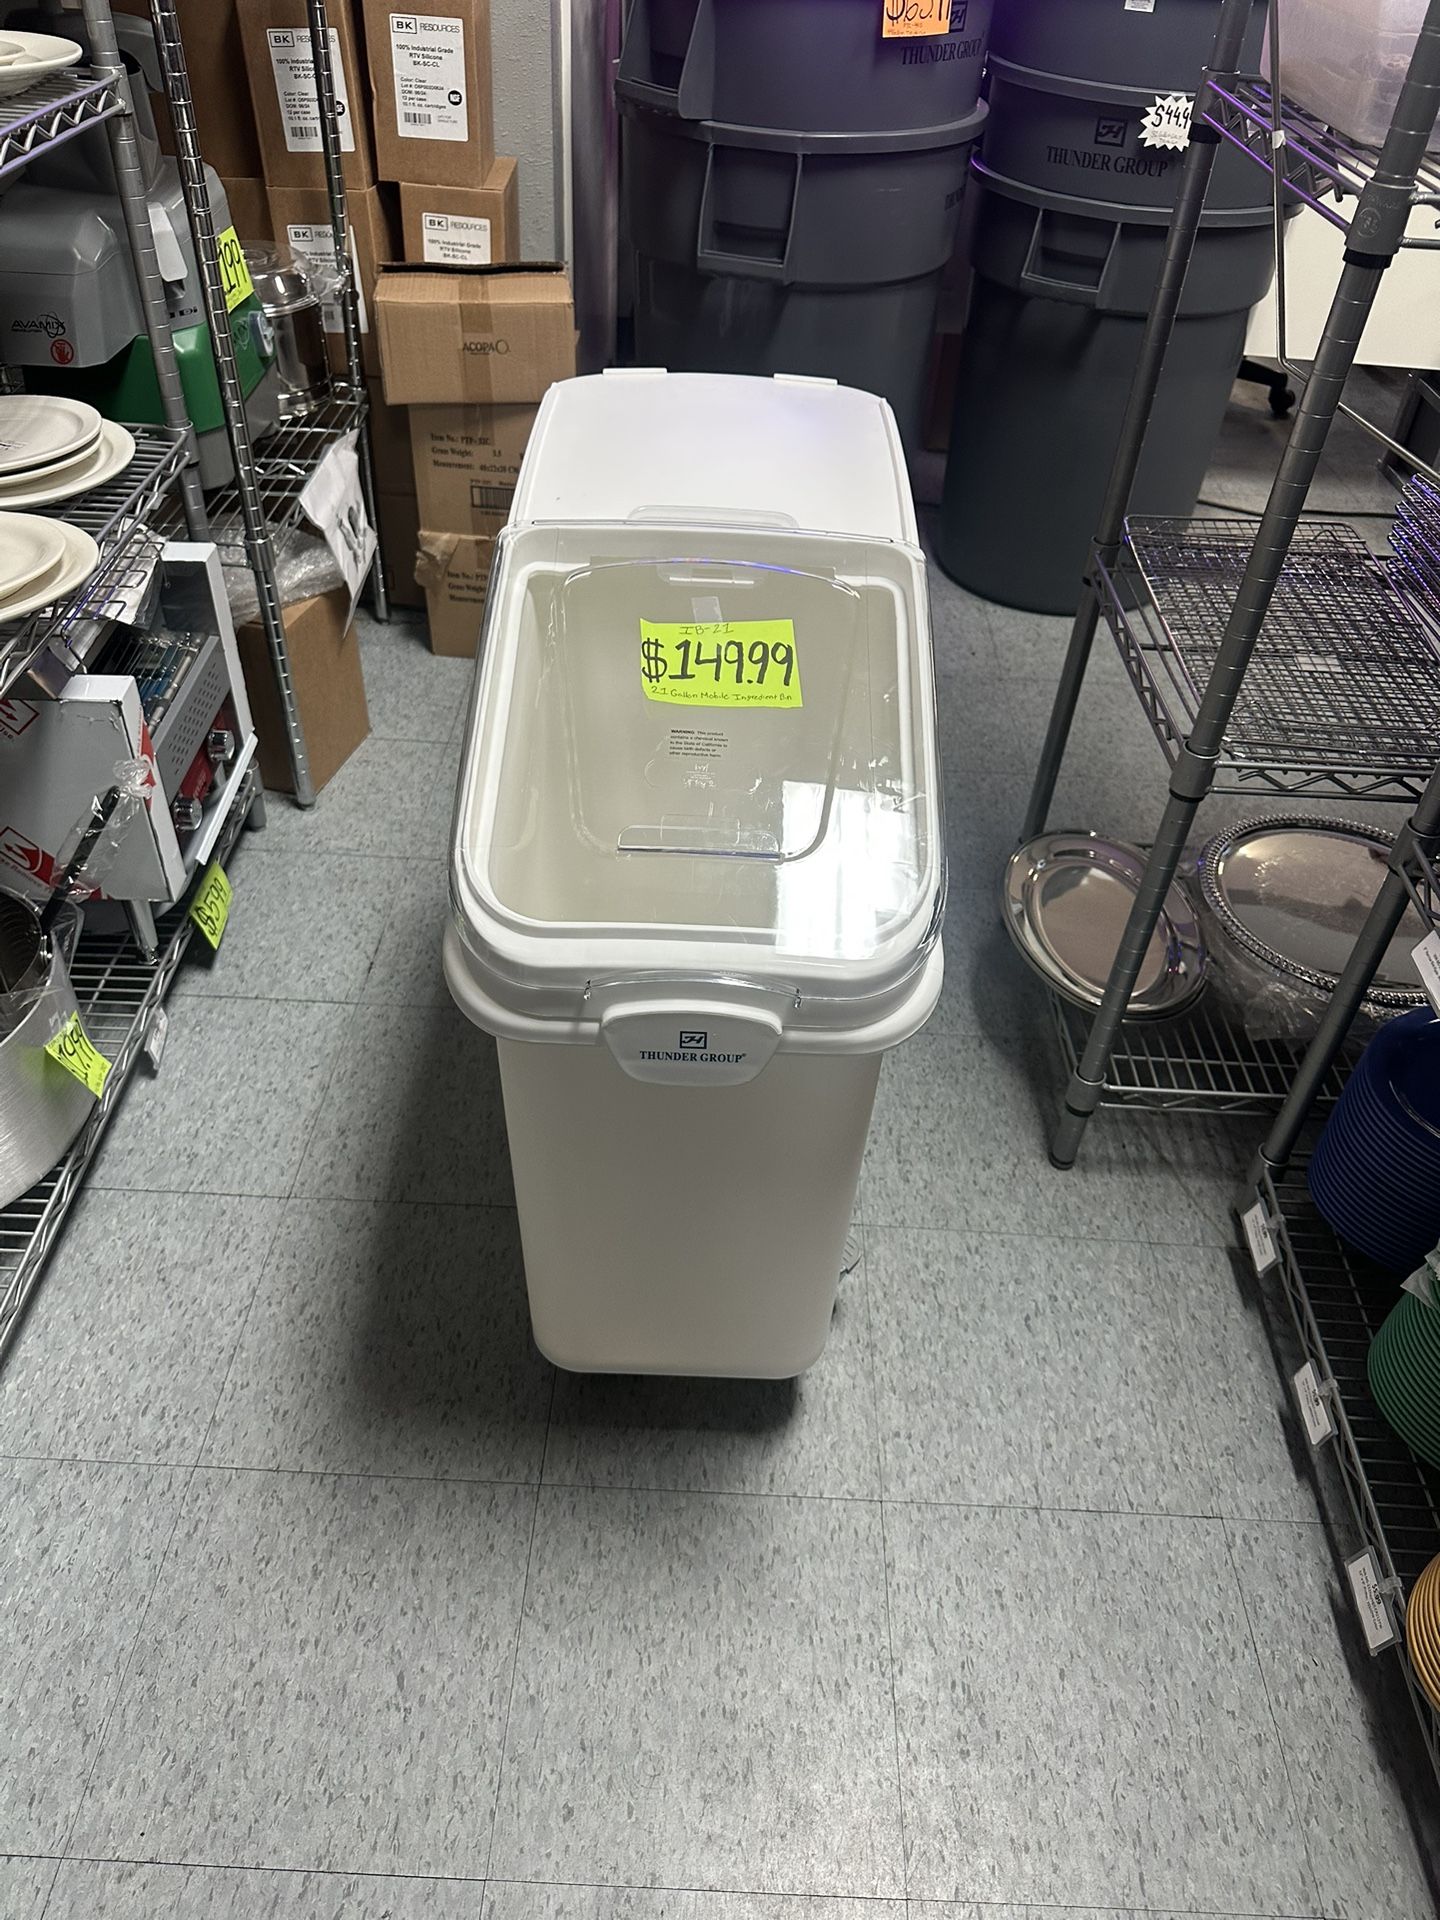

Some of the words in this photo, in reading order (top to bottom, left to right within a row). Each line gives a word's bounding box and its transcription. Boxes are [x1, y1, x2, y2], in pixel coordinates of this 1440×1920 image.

[396, 21, 413, 30] BK
[420, 23, 460, 33] RESOURCES
[273, 35, 290, 43] BK
[396, 43, 410, 51] 100%
[411, 45, 436, 53] Industrial
[901, 43, 956, 65] THUNDER
[1047, 146, 1111, 172] THUNDER
[1114, 155, 1168, 177] GROUP
[429, 219, 444, 228] BK
[450, 221, 488, 232] RESOURCES
[294, 231, 309, 239] BK
[11, 320, 65, 330] AVAMIX
[680, 623, 734, 635] IB-21
[641, 637, 793, 687] $149.99
[651, 685, 668, 695] 21
[670, 688, 698, 699] Gallon
[700, 691, 729, 700] Mobile
[732, 693, 777, 701] Ingredient
[640, 1051, 698, 1062] THUNDER
